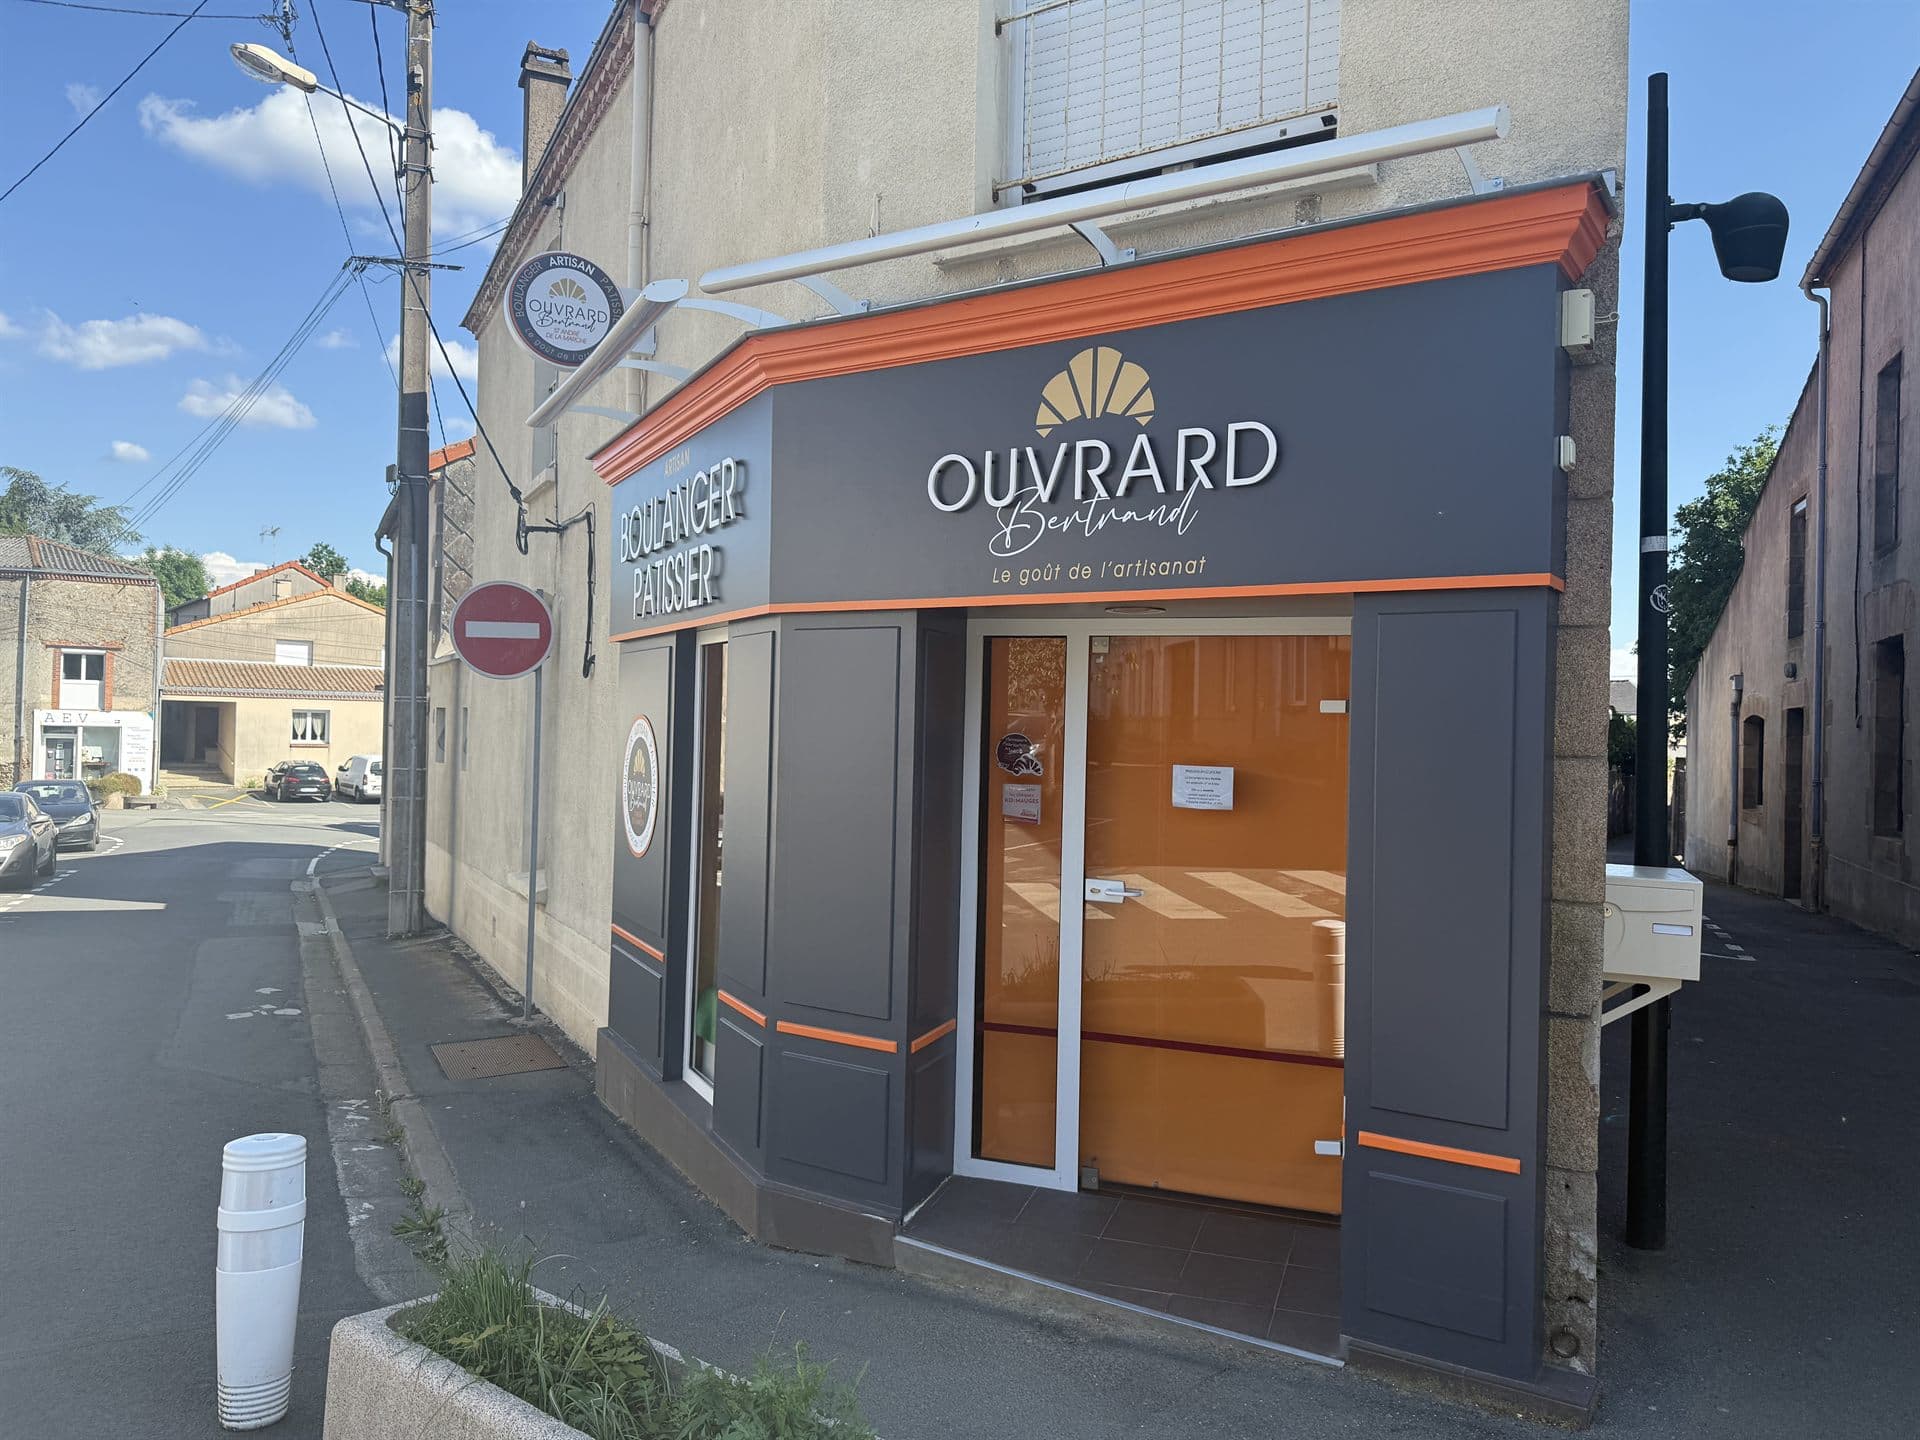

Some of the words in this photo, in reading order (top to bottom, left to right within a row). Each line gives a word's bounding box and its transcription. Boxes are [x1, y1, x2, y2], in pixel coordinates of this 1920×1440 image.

[549, 256, 595, 275] ARTISAN
[514, 261, 542, 317] BOULANGER
[529, 300, 608, 323] OUVRARD
[536, 311, 596, 333] Bertrand
[664, 448, 690, 478] ARTISAN
[927, 421, 1278, 512] OUVRARD
[620, 457, 737, 564] BOULANGER
[988, 479, 1201, 557] Bertrand
[633, 543, 713, 620] PATISSIER
[992, 566, 1010, 585] Le
[1019, 559, 1060, 586] goût
[1069, 563, 1092, 580] de
[1101, 556, 1207, 579] l'artisanat
